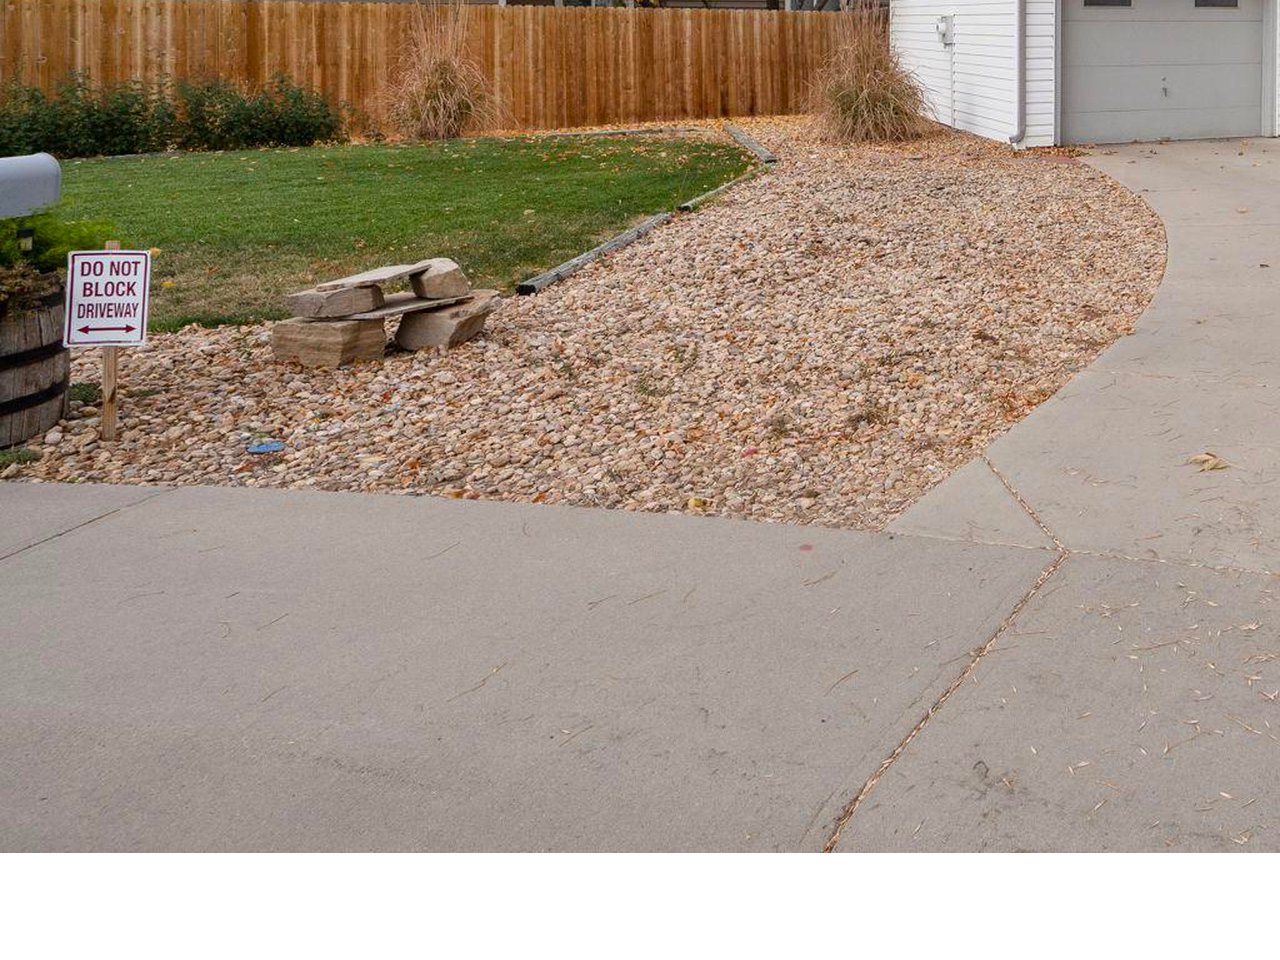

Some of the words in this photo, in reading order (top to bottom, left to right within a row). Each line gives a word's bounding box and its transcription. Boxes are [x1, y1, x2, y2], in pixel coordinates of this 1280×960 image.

[80, 261, 103, 276] DO
[109, 261, 141, 276] NOT
[83, 281, 137, 297] BLOCK
[77, 303, 139, 319] DRIVEWAY
